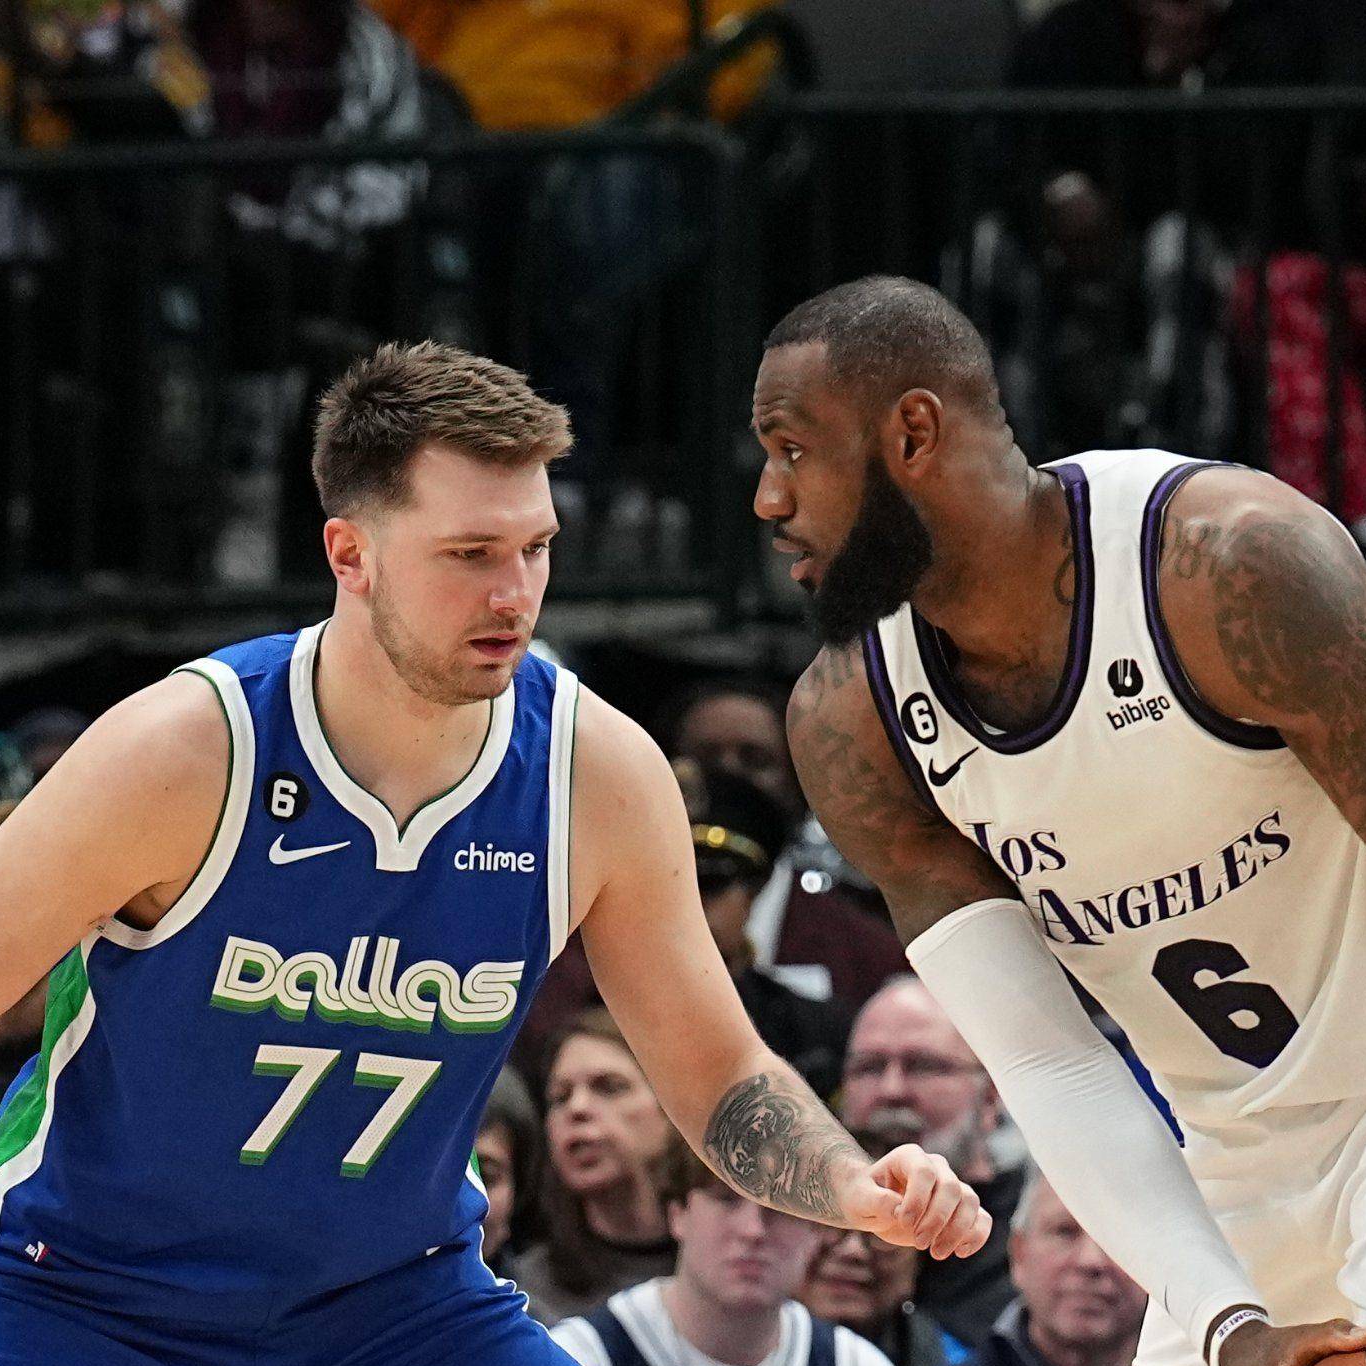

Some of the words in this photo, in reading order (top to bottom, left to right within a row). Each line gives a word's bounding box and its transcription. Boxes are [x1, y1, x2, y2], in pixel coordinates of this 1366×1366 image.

[909, 700, 936, 739] 6
[1106, 695, 1170, 730] bibigo
[270, 778, 298, 818] 6
[454, 842, 535, 873] chime
[1035, 811, 1292, 946] ANGELES
[209, 936, 526, 1033] Dallas
[1151, 938, 1300, 1069] 6
[238, 1043, 443, 1178] 77
